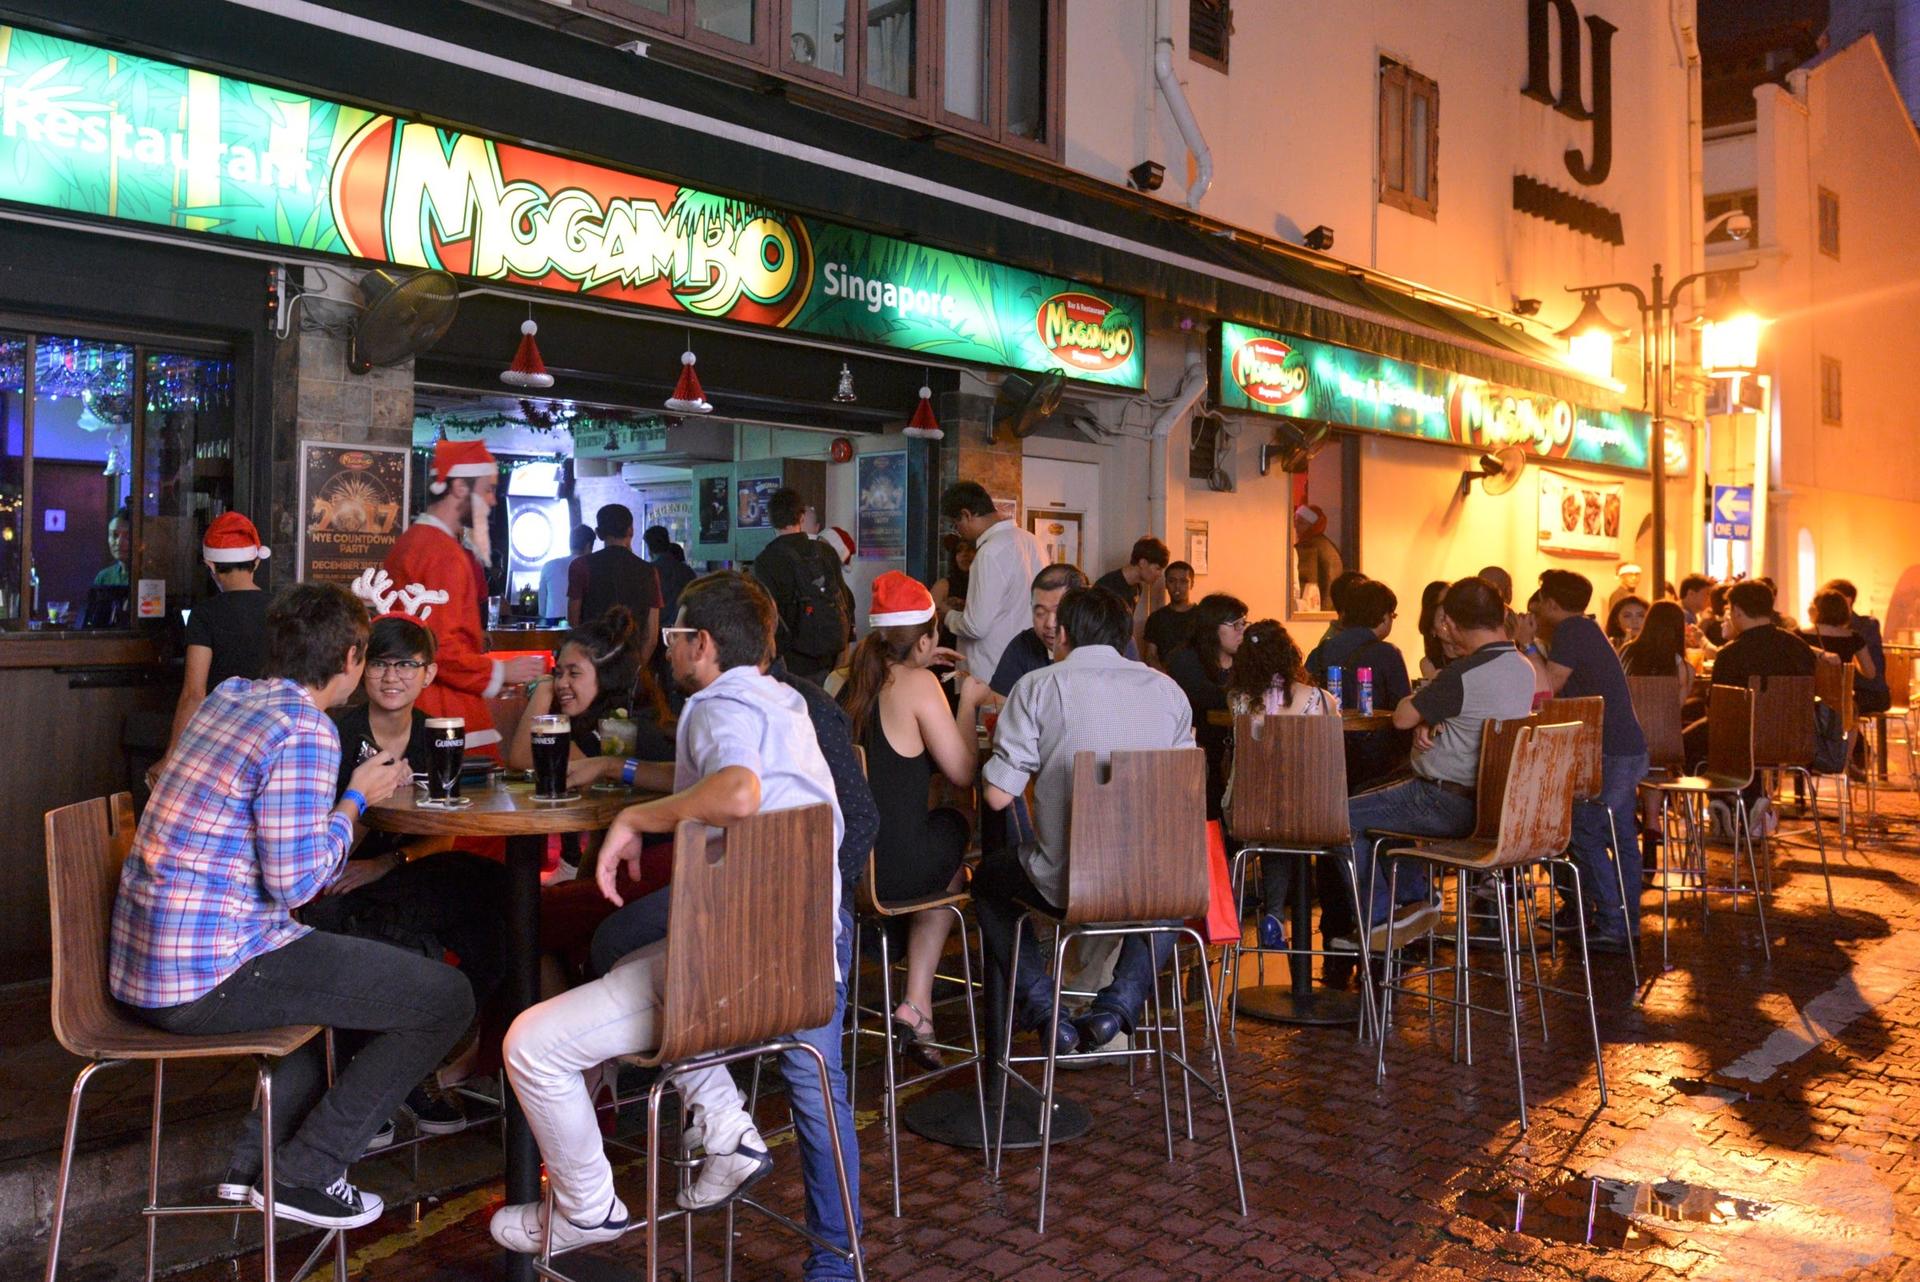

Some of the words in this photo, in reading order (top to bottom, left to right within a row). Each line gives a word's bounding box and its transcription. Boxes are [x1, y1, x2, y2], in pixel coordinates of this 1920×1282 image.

[3, 96, 311, 192] Restaurant
[823, 262, 956, 317] Singapore
[1715, 523, 1732, 536] ONE
[1733, 524, 1750, 537] WAY
[312, 533, 332, 543] NYE
[333, 533, 396, 545] COUNTDOWN
[340, 544, 369, 553] PARTY
[312, 560, 360, 569] DECEMBER
